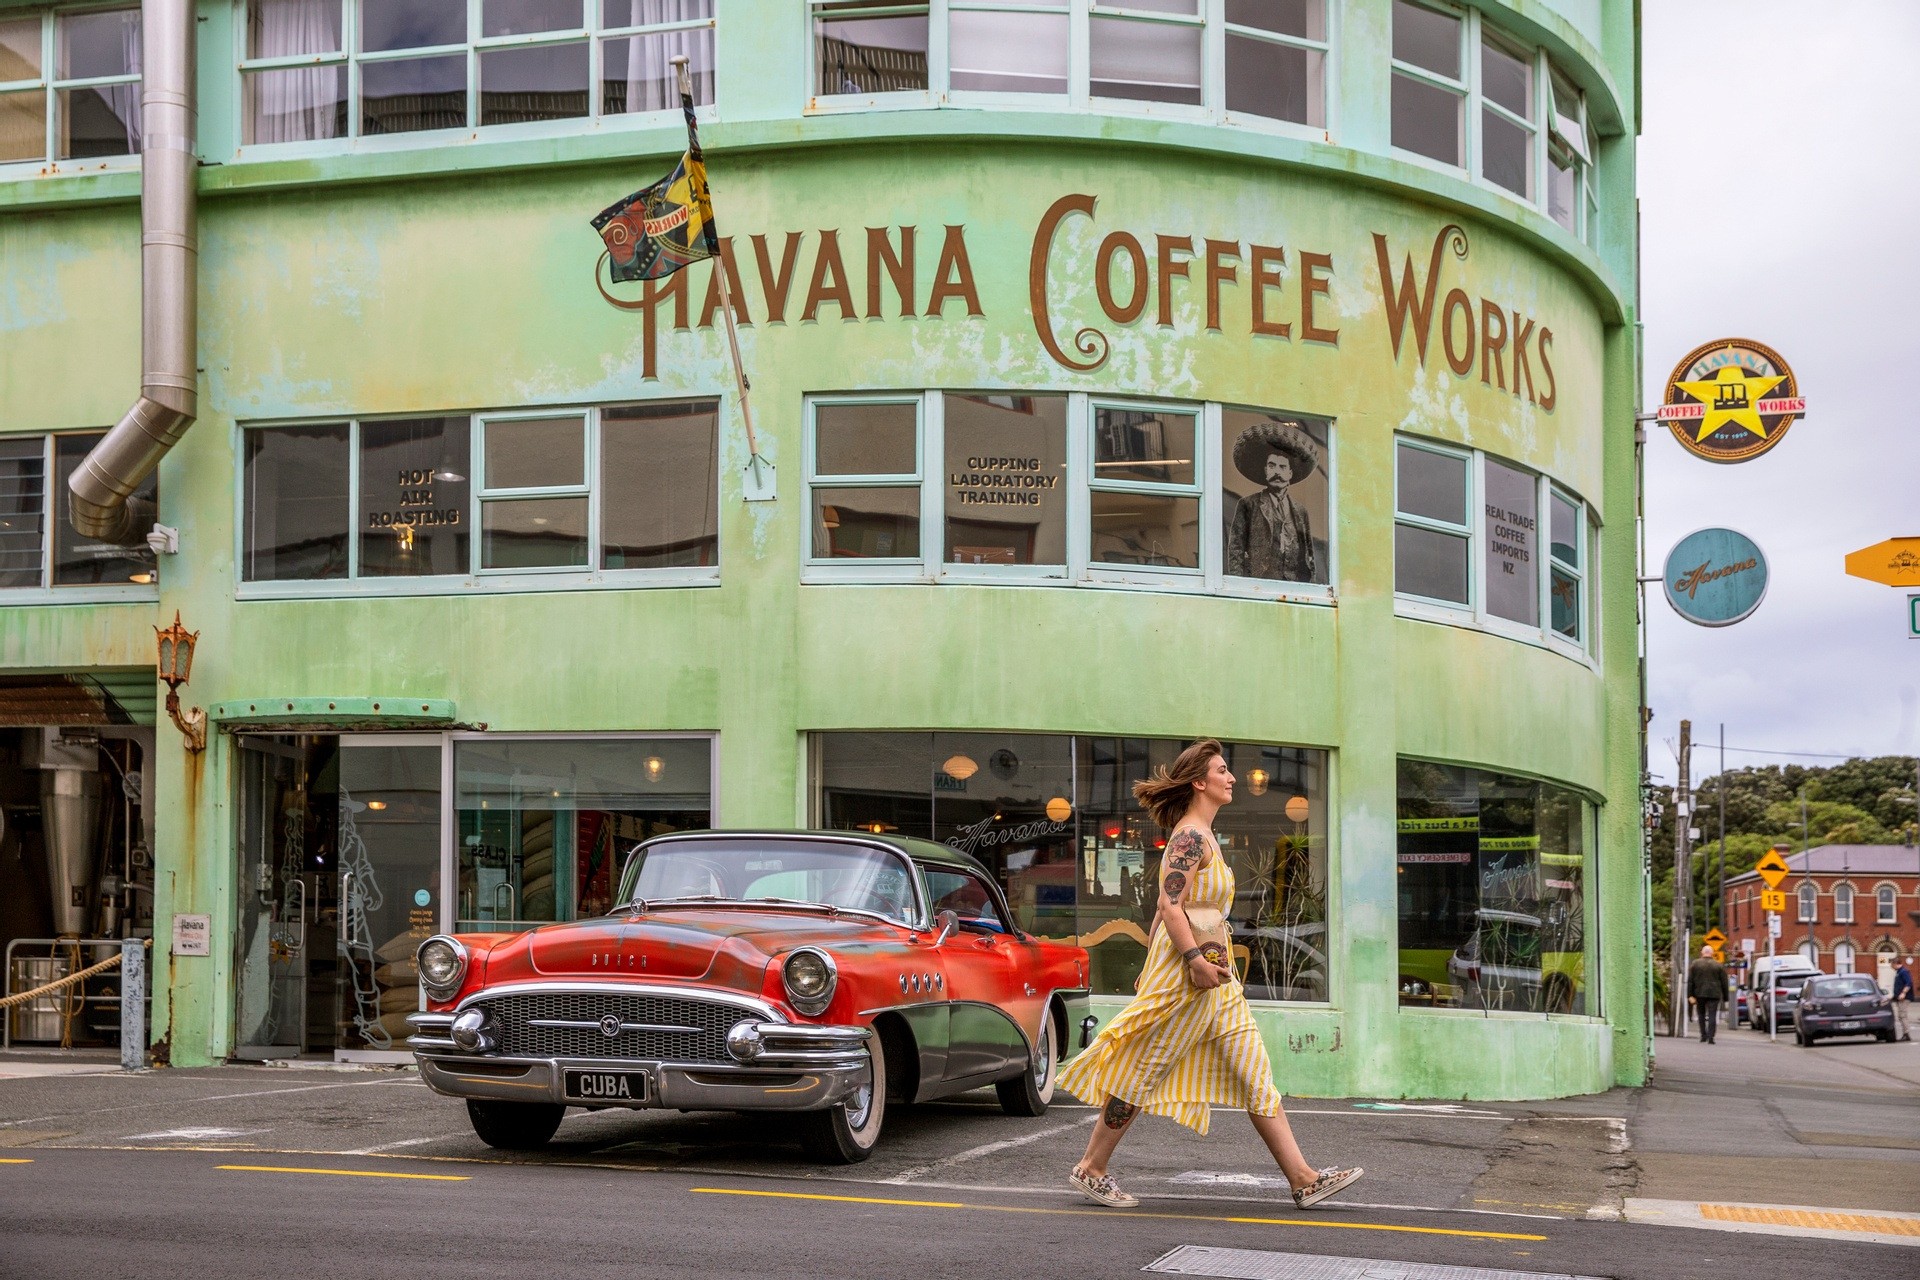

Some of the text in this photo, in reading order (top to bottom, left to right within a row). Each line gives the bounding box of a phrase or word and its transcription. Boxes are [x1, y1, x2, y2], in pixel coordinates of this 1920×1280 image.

[595, 193, 1557, 411] HAVANA COFFEE WORKS
[1692, 352, 1769, 378] HAVANA
[1658, 399, 1806, 418] COFFEE WORKS
[967, 457, 1041, 472] CUPPING
[398, 469, 435, 486] HOT
[951, 474, 1058, 489] LABORATORY
[400, 489, 434, 507] AIR
[958, 491, 1041, 506] TRAINING
[368, 509, 460, 528] ROASTING
[1485, 504, 1534, 531] REAL TRADE
[1495, 525, 1526, 545] COFFEE
[1491, 540, 1530, 562] IMPORTS
[1503, 561, 1515, 574] NZ
[1673, 555, 1758, 600] Havana
[944, 812, 1066, 855] Havana
[1766, 894, 1780, 906] 15
[579, 1074, 631, 1097] CUBA
